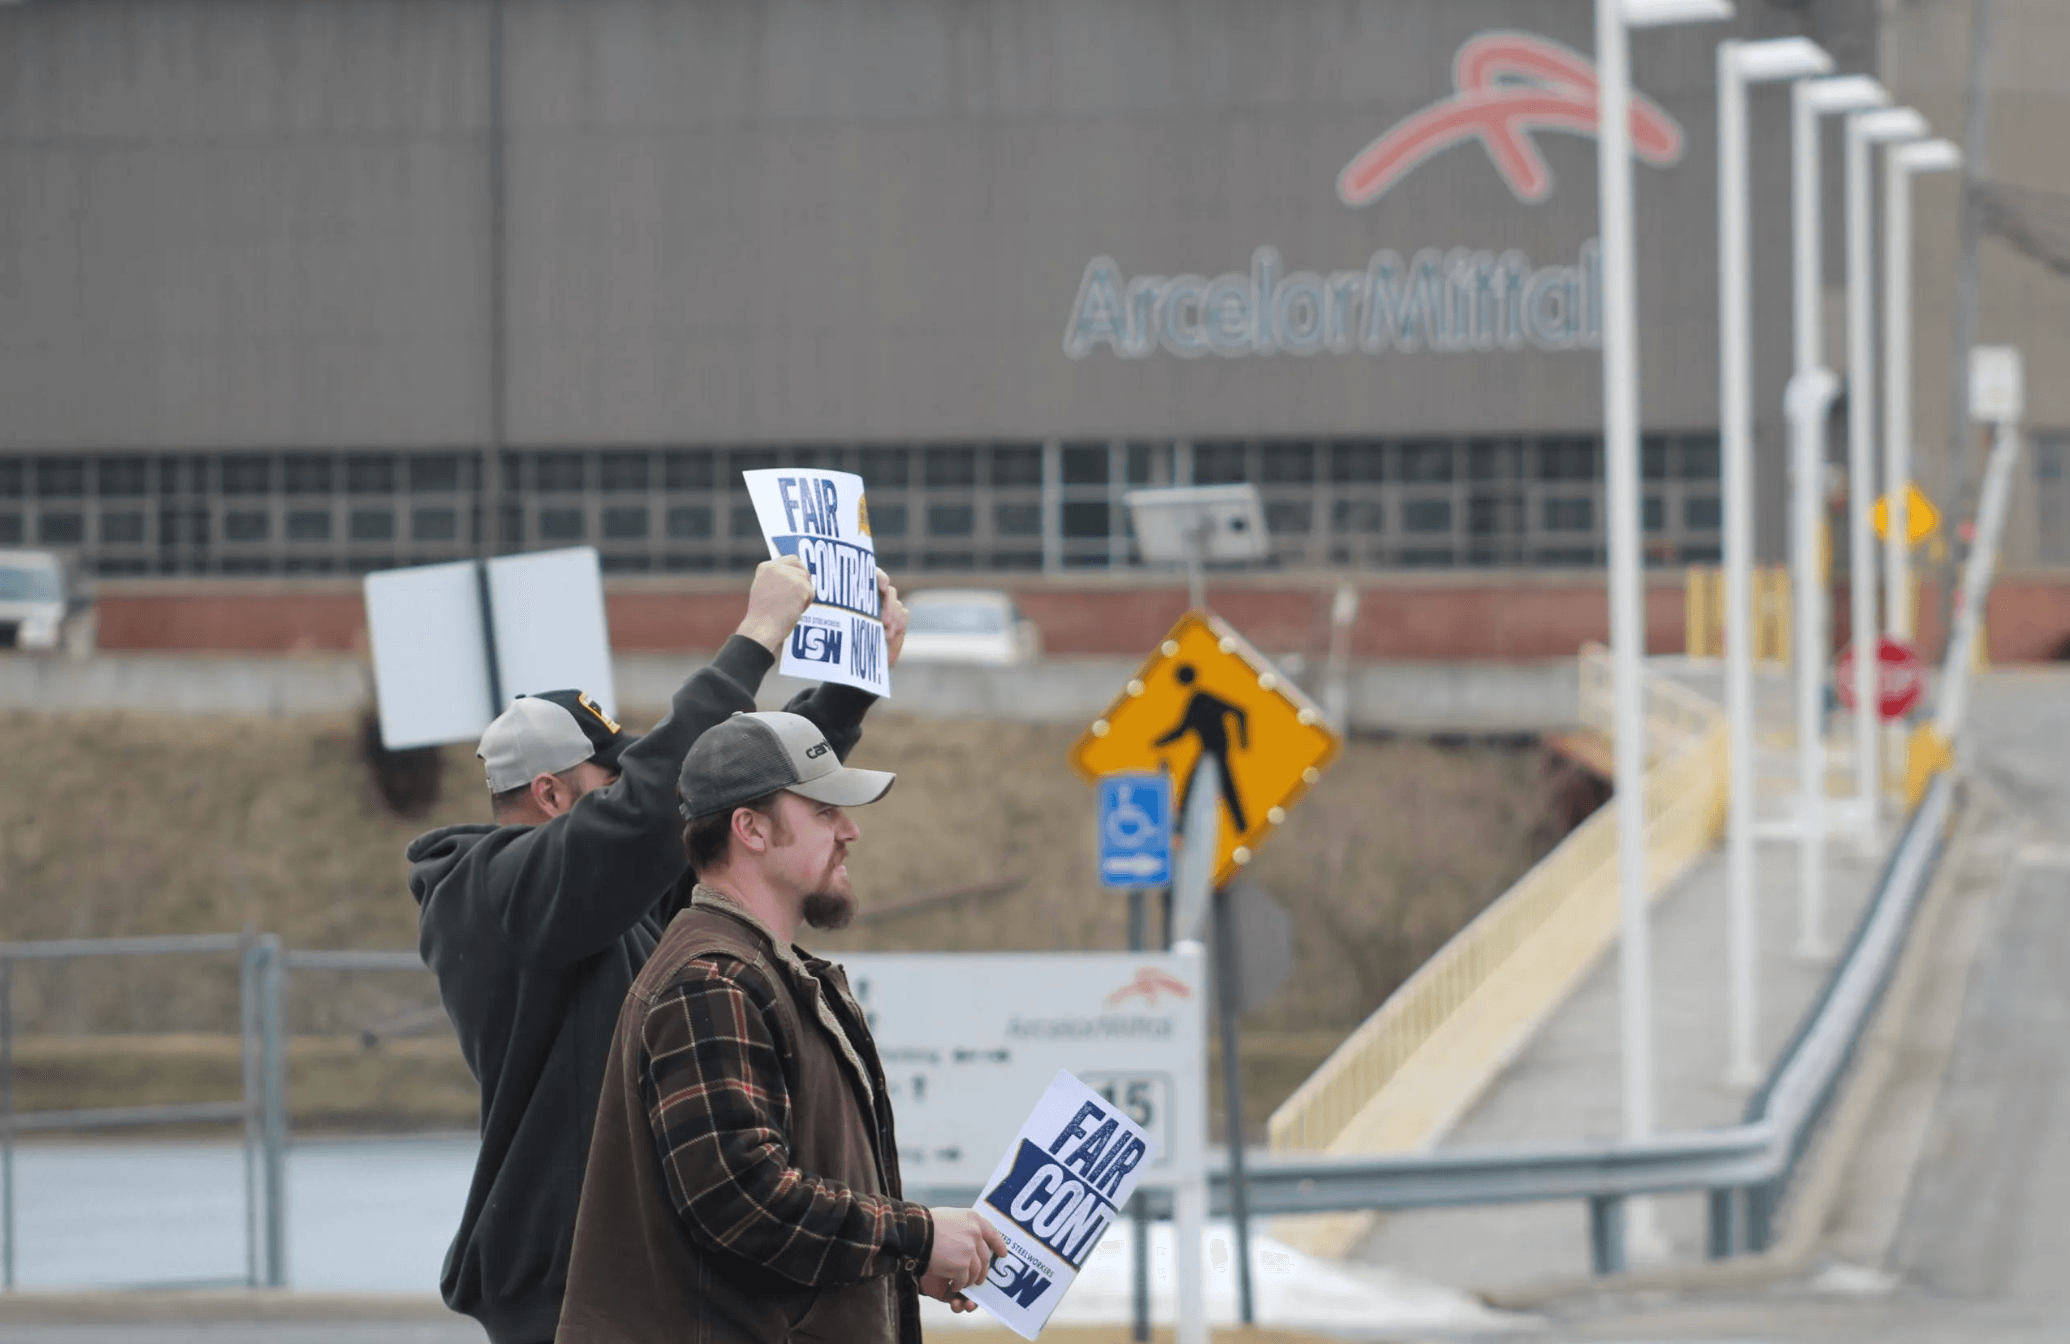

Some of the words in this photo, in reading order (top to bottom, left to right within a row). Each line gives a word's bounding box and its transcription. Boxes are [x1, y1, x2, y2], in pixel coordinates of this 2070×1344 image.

[1064, 238, 1604, 358] ArcelorMittal
[777, 477, 840, 538] FAIR
[798, 537, 878, 617] CONTRACT
[791, 624, 843, 665] USW
[850, 616, 882, 685] NOW!
[1048, 1100, 1146, 1199] FAIR
[986, 1250, 1052, 1309] SW
[1011, 1242, 1055, 1278] STEELWORKERS
